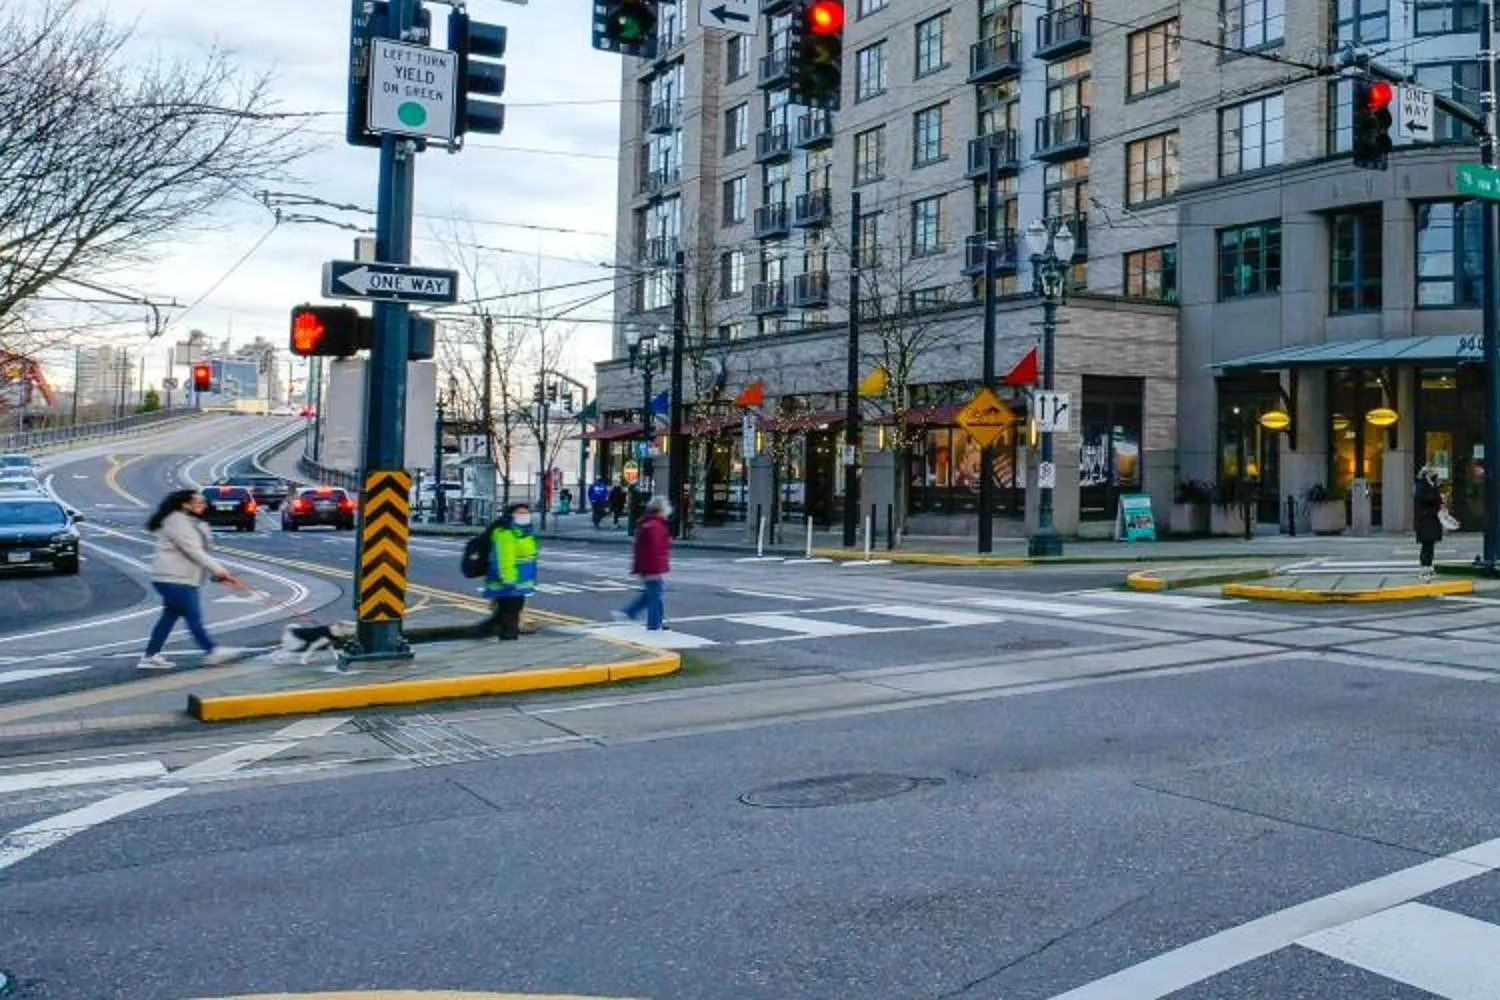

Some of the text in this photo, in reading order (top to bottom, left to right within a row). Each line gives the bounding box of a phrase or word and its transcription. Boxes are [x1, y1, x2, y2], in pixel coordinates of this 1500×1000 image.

[383, 47, 447, 68] LEFT TURN
[394, 65, 435, 85] YIELD
[383, 81, 443, 102] ON GREEN
[1405, 88, 1430, 105] ONE
[1404, 103, 1430, 118] WAY
[370, 274, 445, 293] ONE WAY
